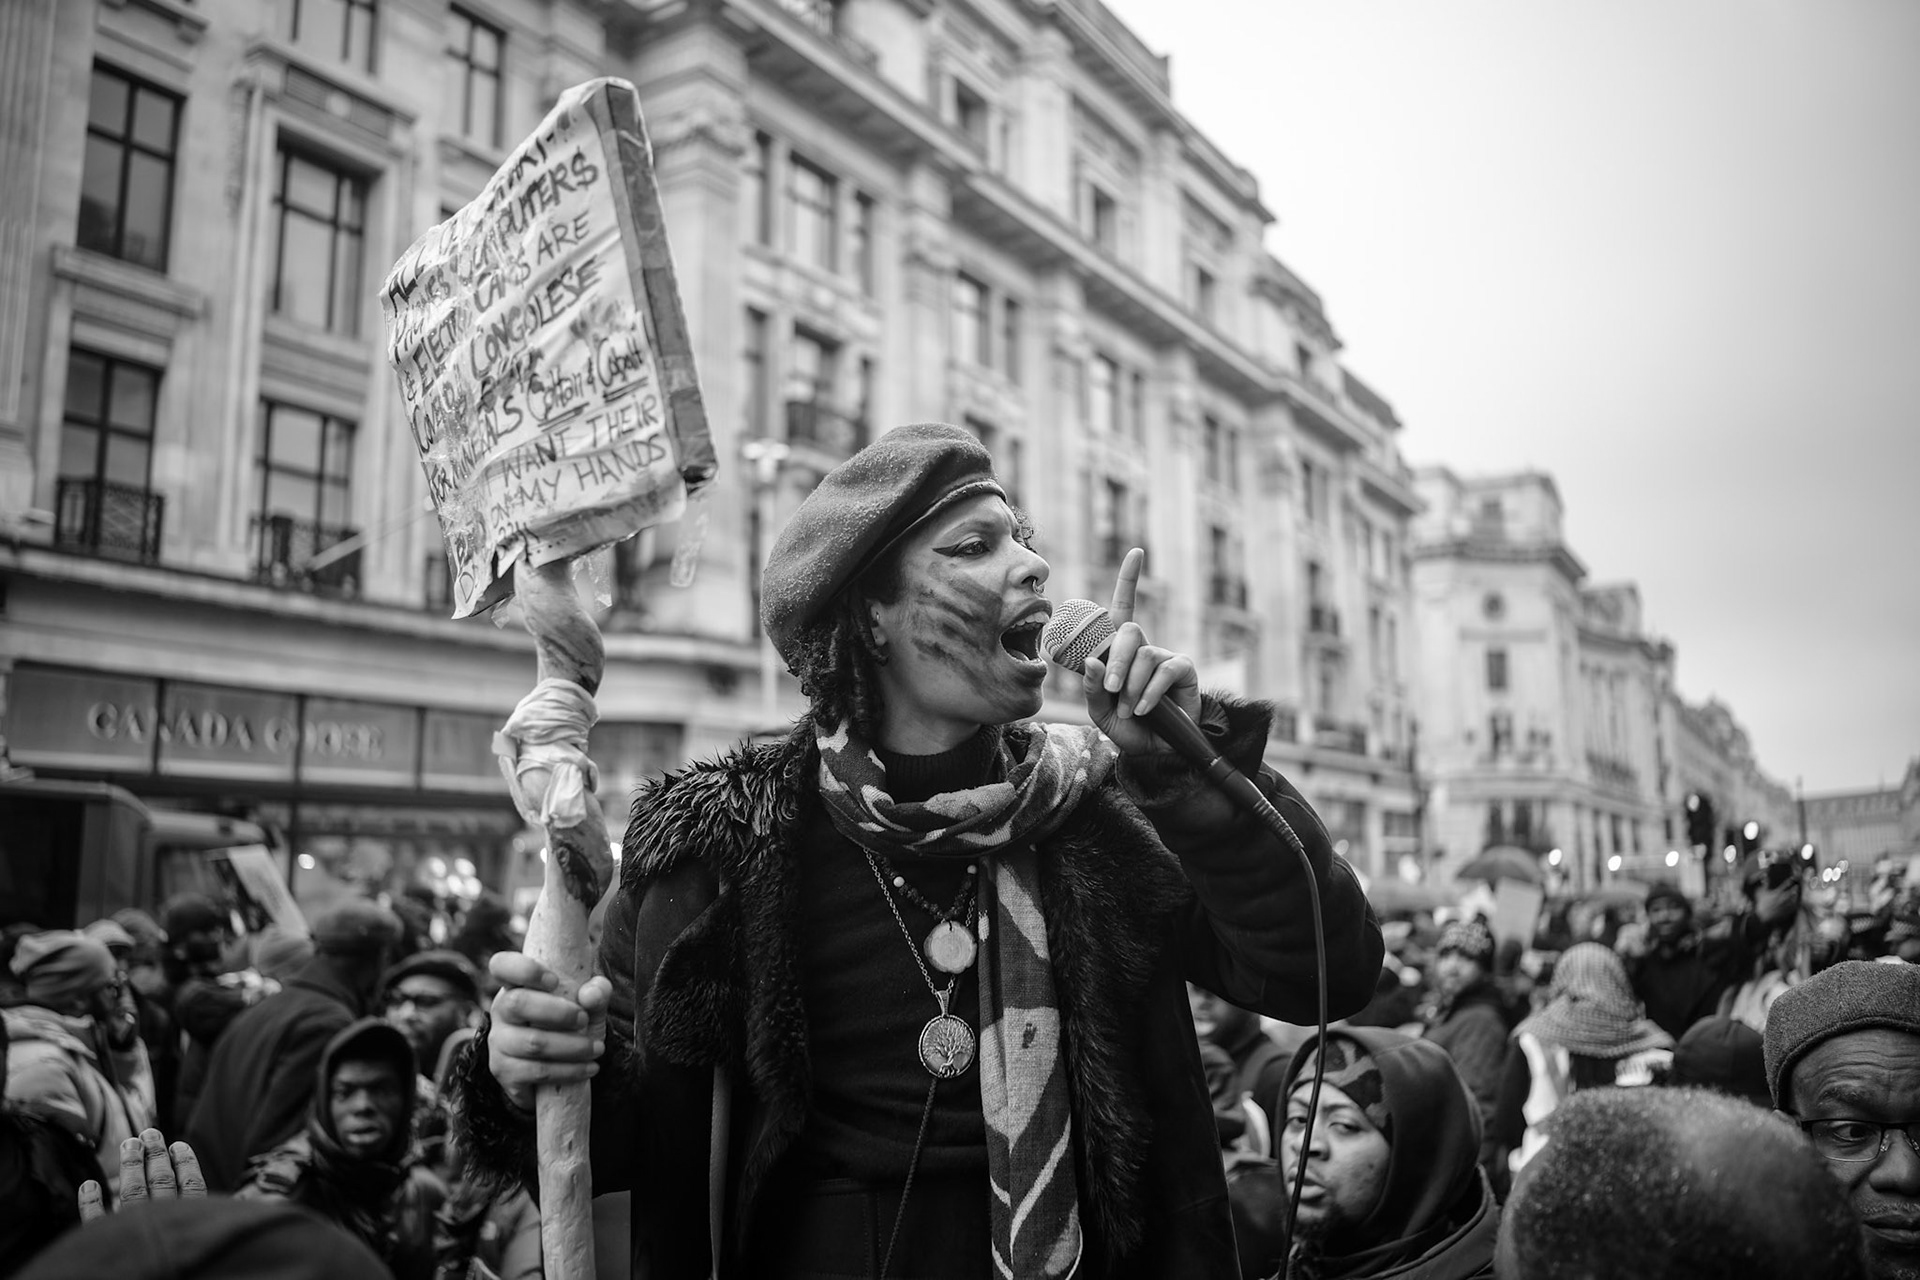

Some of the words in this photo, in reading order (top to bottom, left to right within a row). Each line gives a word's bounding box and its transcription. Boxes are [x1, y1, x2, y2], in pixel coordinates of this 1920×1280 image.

[536, 210, 591, 266] ARE
[470, 258, 602, 381] CONGOLESE
[501, 427, 571, 488] WANT
[586, 394, 659, 450] THEIR
[518, 469, 561, 507] MY
[573, 432, 666, 492] HANDS
